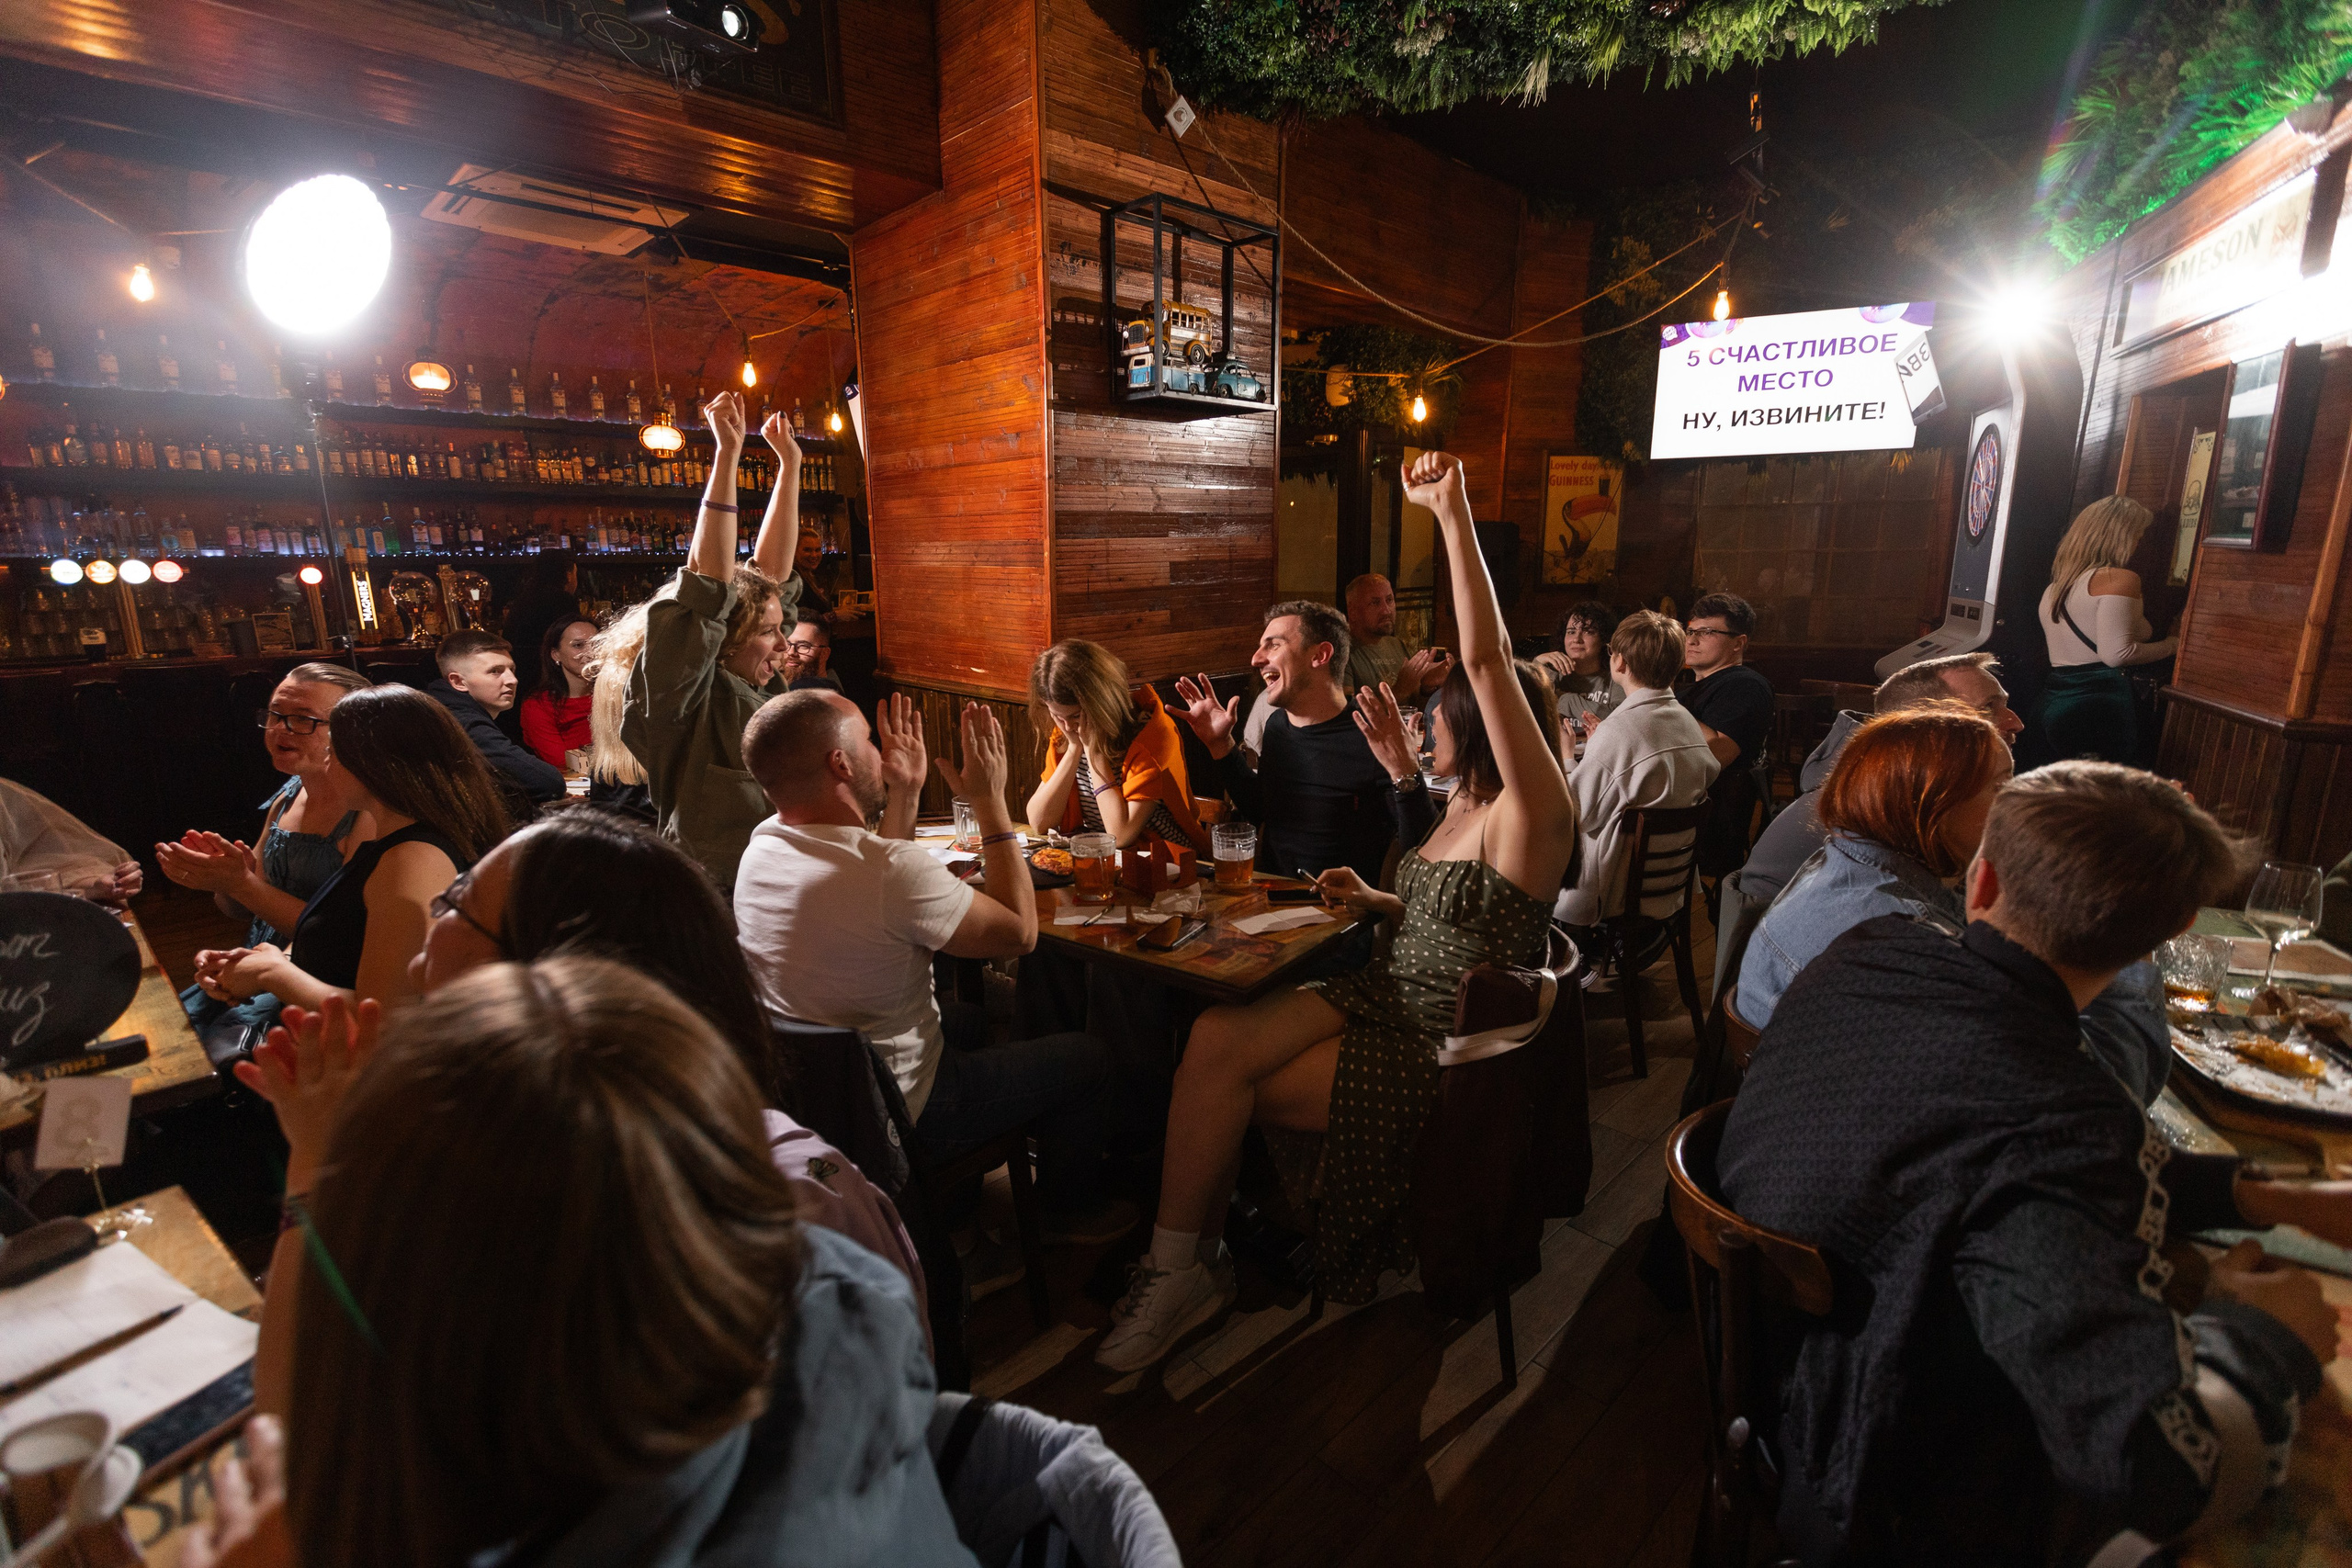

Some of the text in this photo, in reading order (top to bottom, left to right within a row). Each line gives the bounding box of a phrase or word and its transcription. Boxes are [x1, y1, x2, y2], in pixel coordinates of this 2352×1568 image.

[1687, 333, 1898, 367] 5 СЧАСТЛИВОЕ
[1737, 368, 1833, 391] МЕСТО
[1682, 400, 1886, 432] НУ, ИЗВИНИТЕ!
[1551, 460, 1579, 472] Lovely
[1581, 460, 1598, 472] day
[1549, 474, 1594, 487] GUINNESS
[356, 581, 374, 622] MAGNERS
